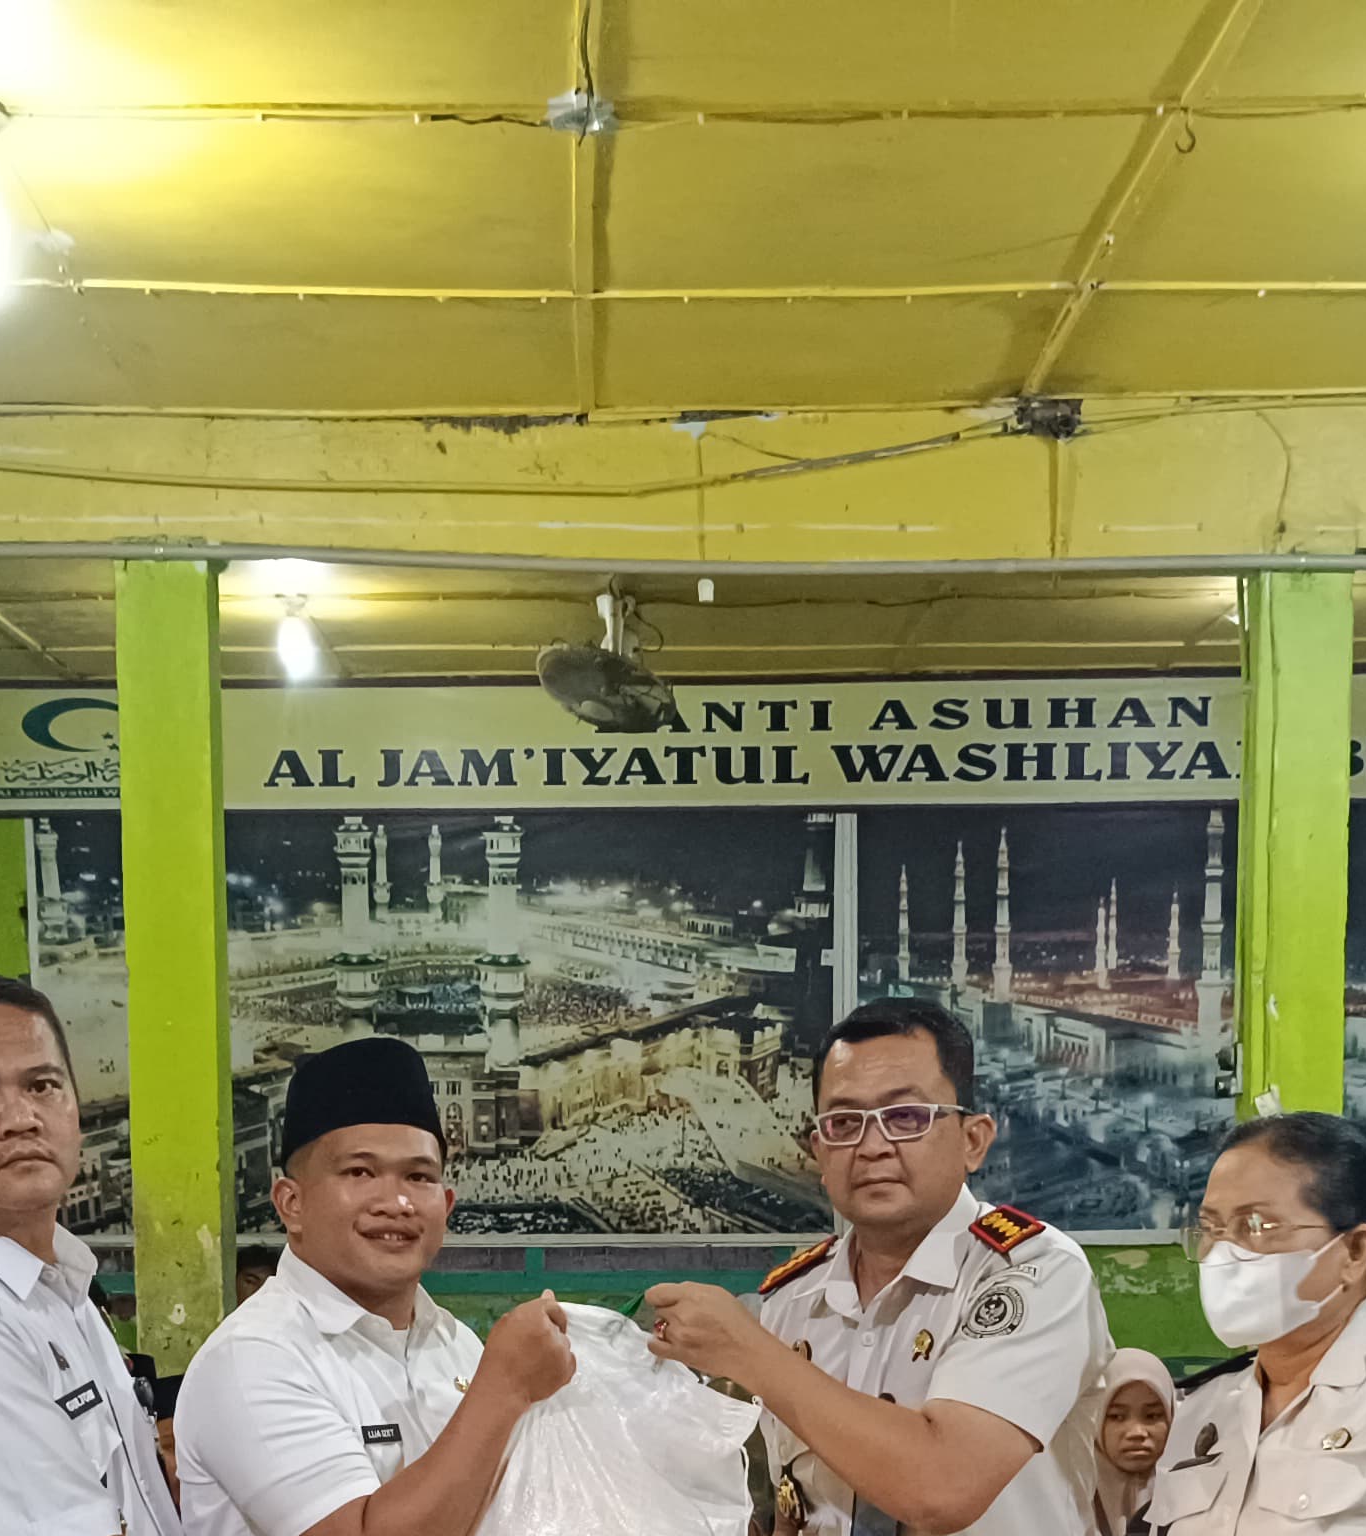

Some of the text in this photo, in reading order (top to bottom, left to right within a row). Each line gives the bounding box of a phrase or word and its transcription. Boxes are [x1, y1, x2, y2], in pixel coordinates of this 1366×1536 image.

[595, 696, 1212, 733] ANTI ASUHAN
[264, 749, 356, 788] AL
[377, 745, 810, 787] JAM'IYATUL
[831, 741, 1241, 783] WASHLIYA
